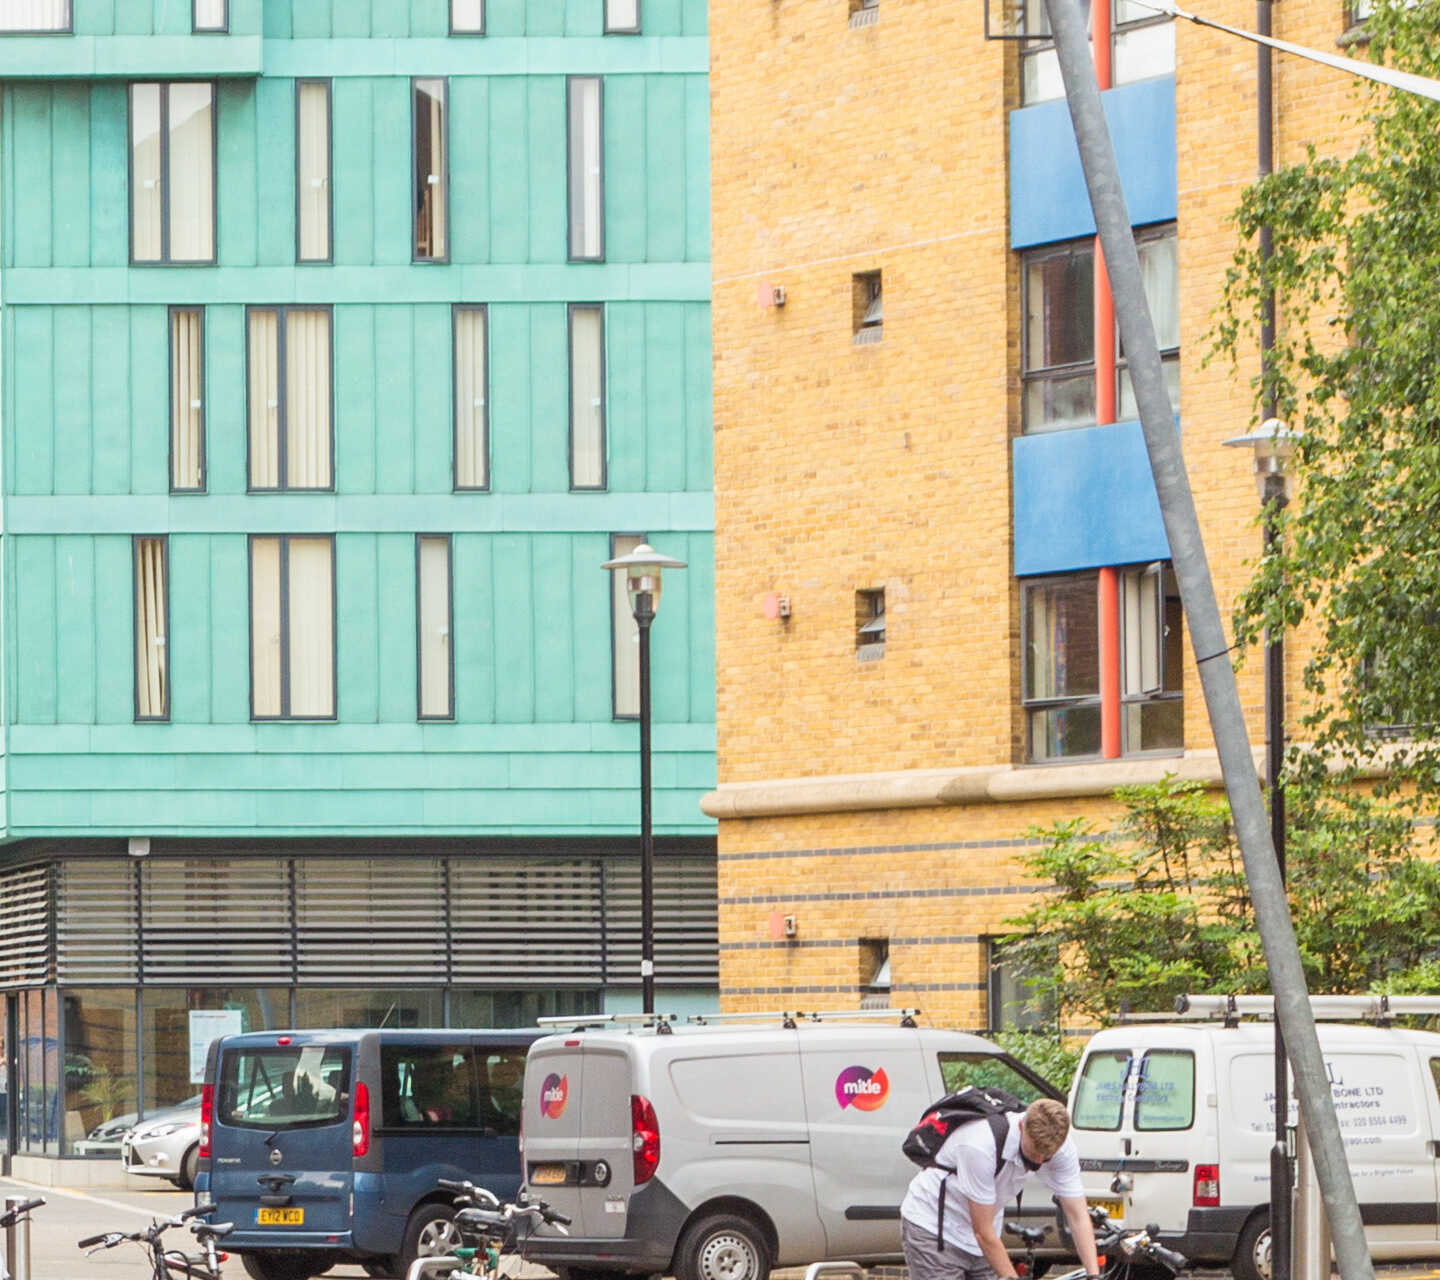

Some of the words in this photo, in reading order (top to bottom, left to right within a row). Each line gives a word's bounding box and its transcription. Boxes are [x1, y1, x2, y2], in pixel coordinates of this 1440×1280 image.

[844, 1078, 882, 1095] mitie
[1365, 1086, 1383, 1096] LTD
[1334, 1098, 1380, 1109] ntractors
